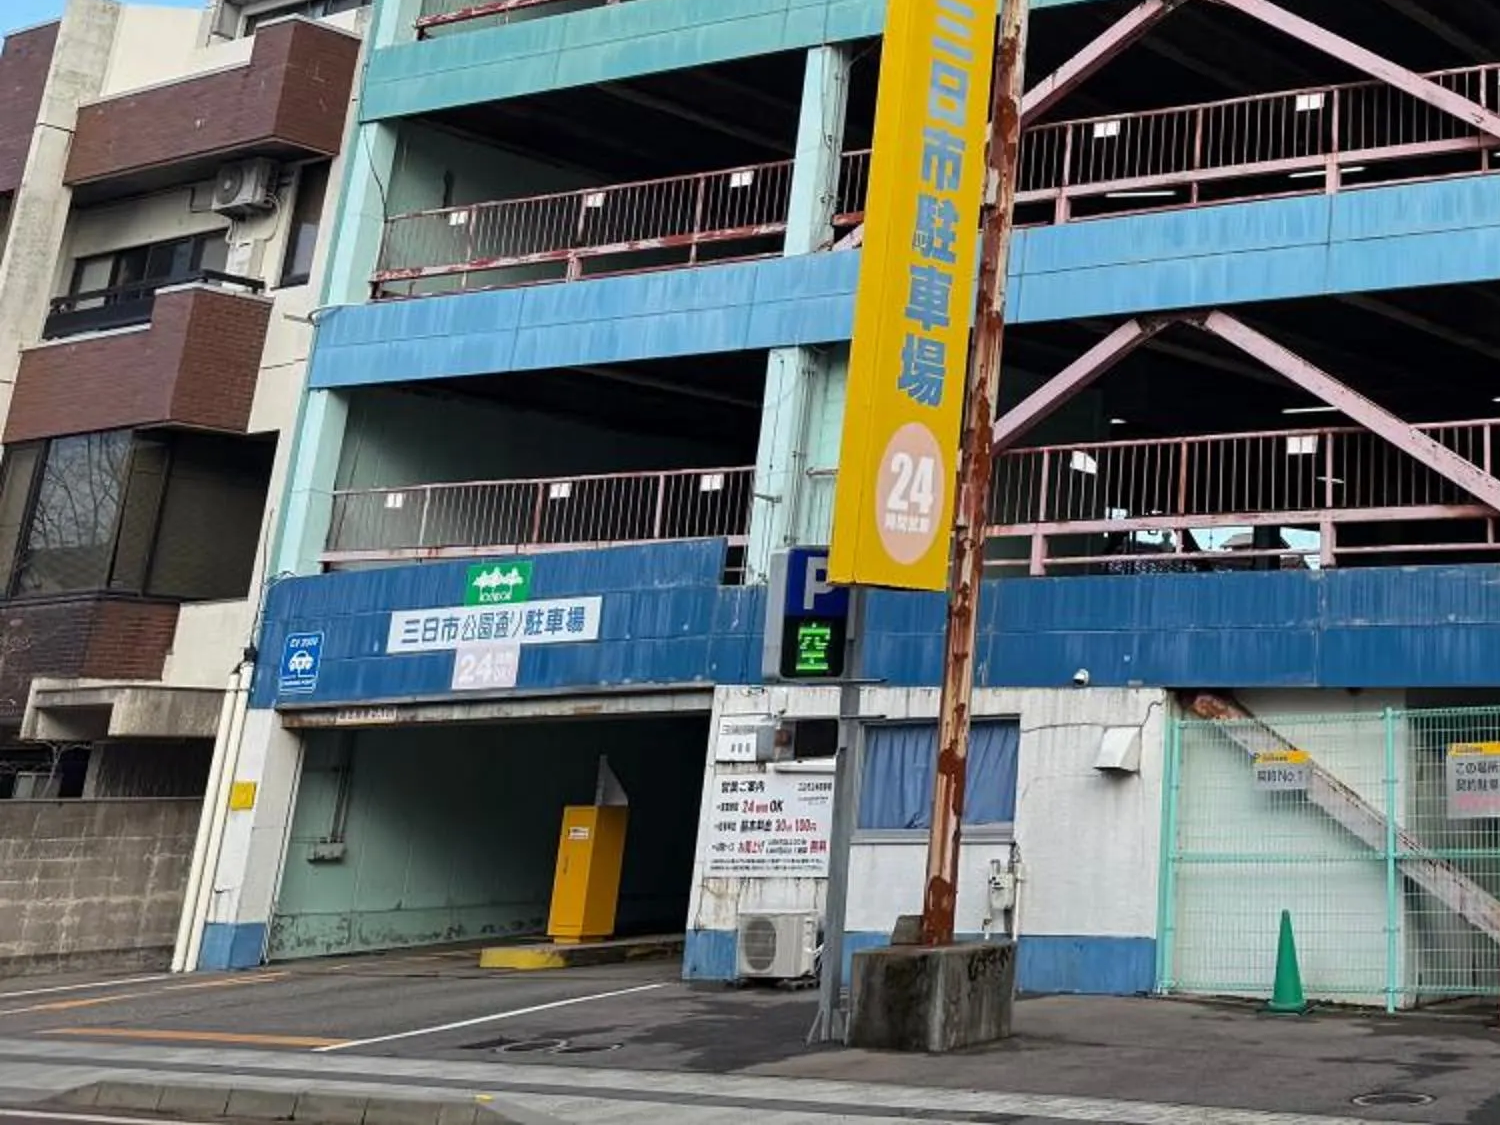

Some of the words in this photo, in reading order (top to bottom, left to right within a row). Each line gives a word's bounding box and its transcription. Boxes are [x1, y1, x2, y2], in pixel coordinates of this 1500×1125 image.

[887, 452, 935, 514] 24
[803, 556, 838, 610] P
[401, 605, 586, 644] 三日市公園通り駐車場
[795, 622, 831, 671] 空
[459, 653, 493, 684] 24
